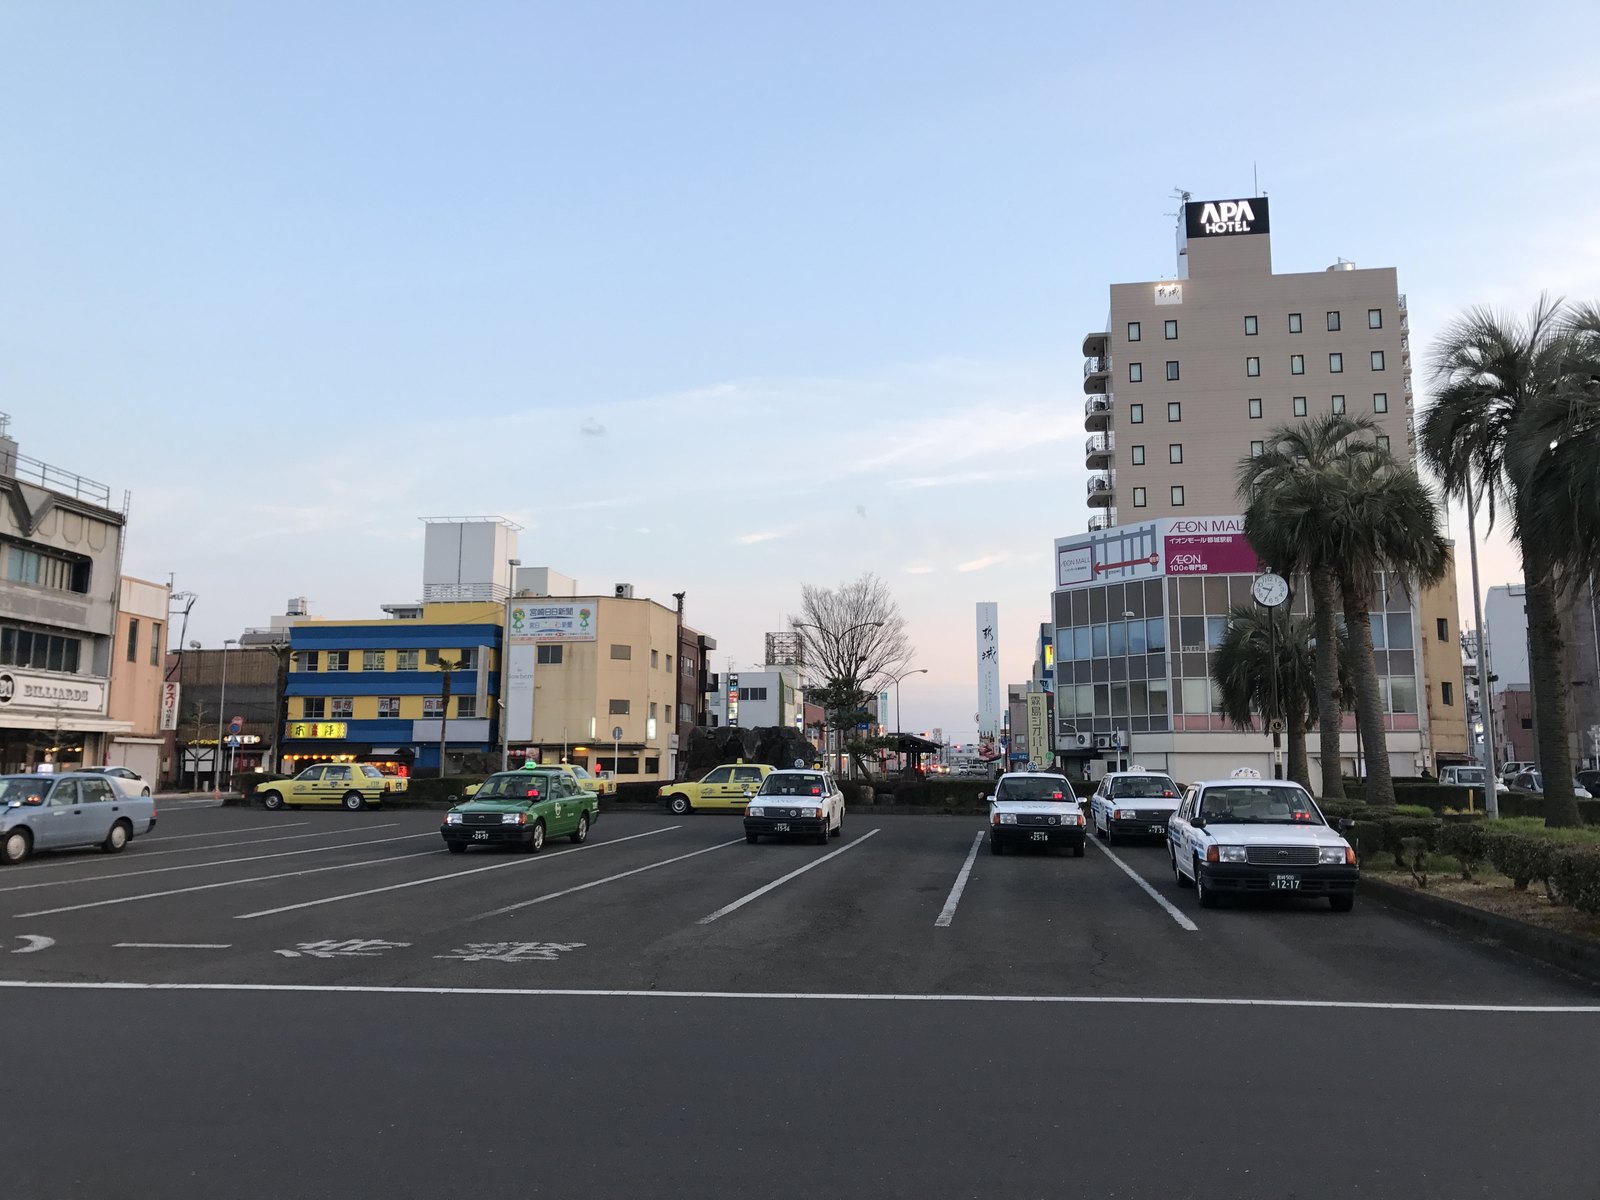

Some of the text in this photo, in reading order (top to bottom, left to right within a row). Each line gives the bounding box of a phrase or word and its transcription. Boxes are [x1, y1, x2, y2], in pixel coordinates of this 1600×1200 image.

[1200, 200, 1255, 224] APA
[1205, 221, 1251, 234] HOTEL
[1169, 564, 1208, 572] 100の専門店
[529, 607, 574, 616] 宮崎日日新聞
[23, 684, 89, 702] BILLIARDS
[1277, 879, 1300, 889] 12-17
